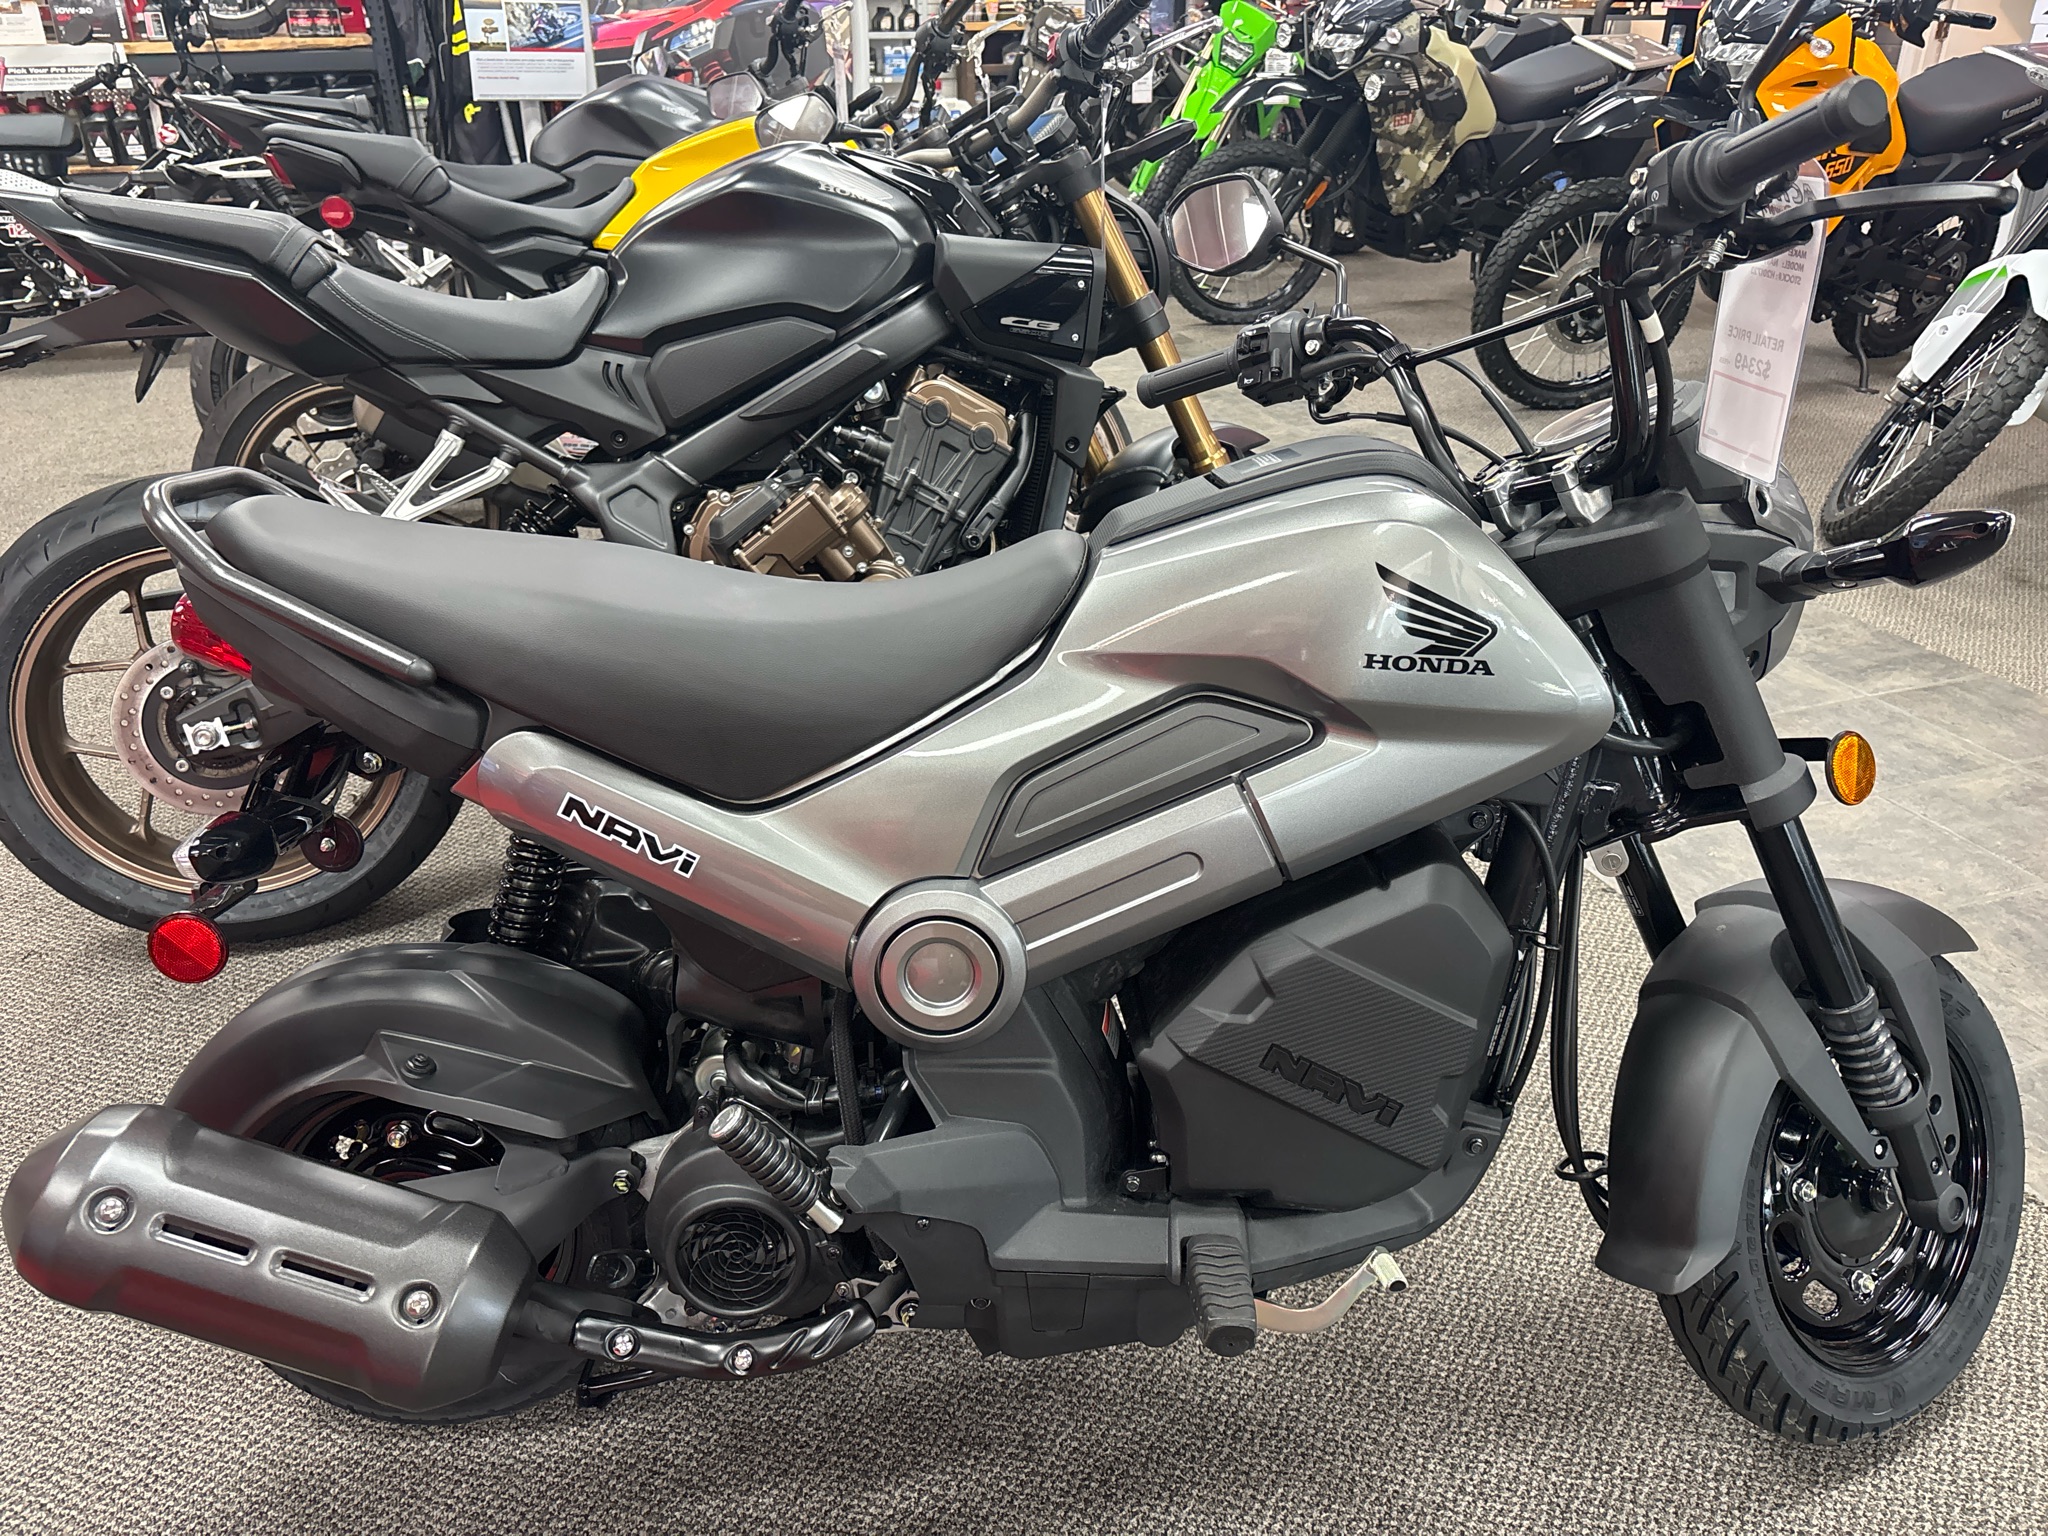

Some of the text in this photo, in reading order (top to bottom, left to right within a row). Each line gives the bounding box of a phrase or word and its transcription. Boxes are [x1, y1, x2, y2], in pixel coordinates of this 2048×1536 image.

[1573, 75, 1608, 95] Kawasaki
[2001, 95, 2043, 120] Kawasaki
[1825, 156, 1854, 179] 650
[1363, 653, 1495, 676] HONDA
